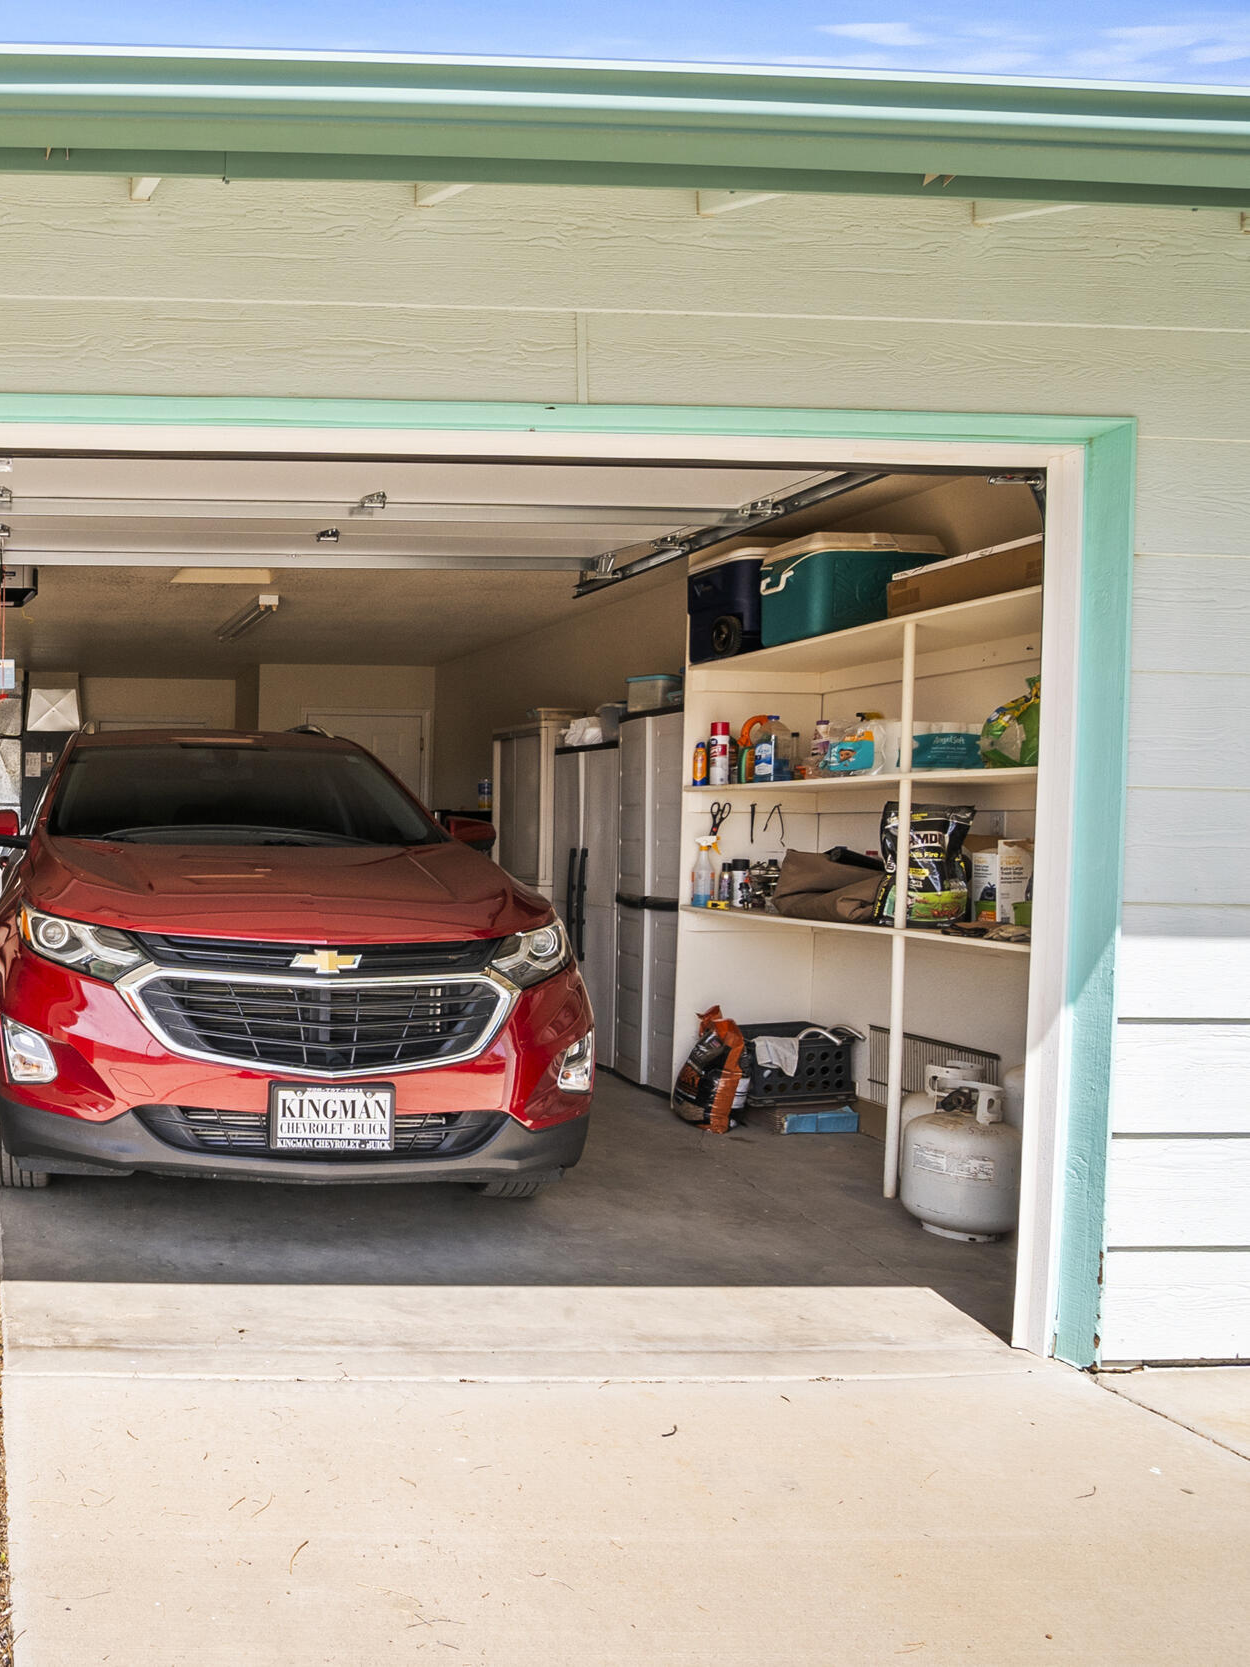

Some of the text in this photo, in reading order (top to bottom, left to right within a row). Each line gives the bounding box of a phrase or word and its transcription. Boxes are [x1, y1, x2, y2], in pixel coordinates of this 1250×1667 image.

[281, 1098, 387, 1119] KINGMAN
[280, 1122, 344, 1135] CHEVROLET
[353, 1122, 387, 1135] BUICK
[277, 1138, 313, 1148] KINGMAN
[314, 1139, 360, 1149] CHEVROLET
[366, 1140, 391, 1150] BUICK
